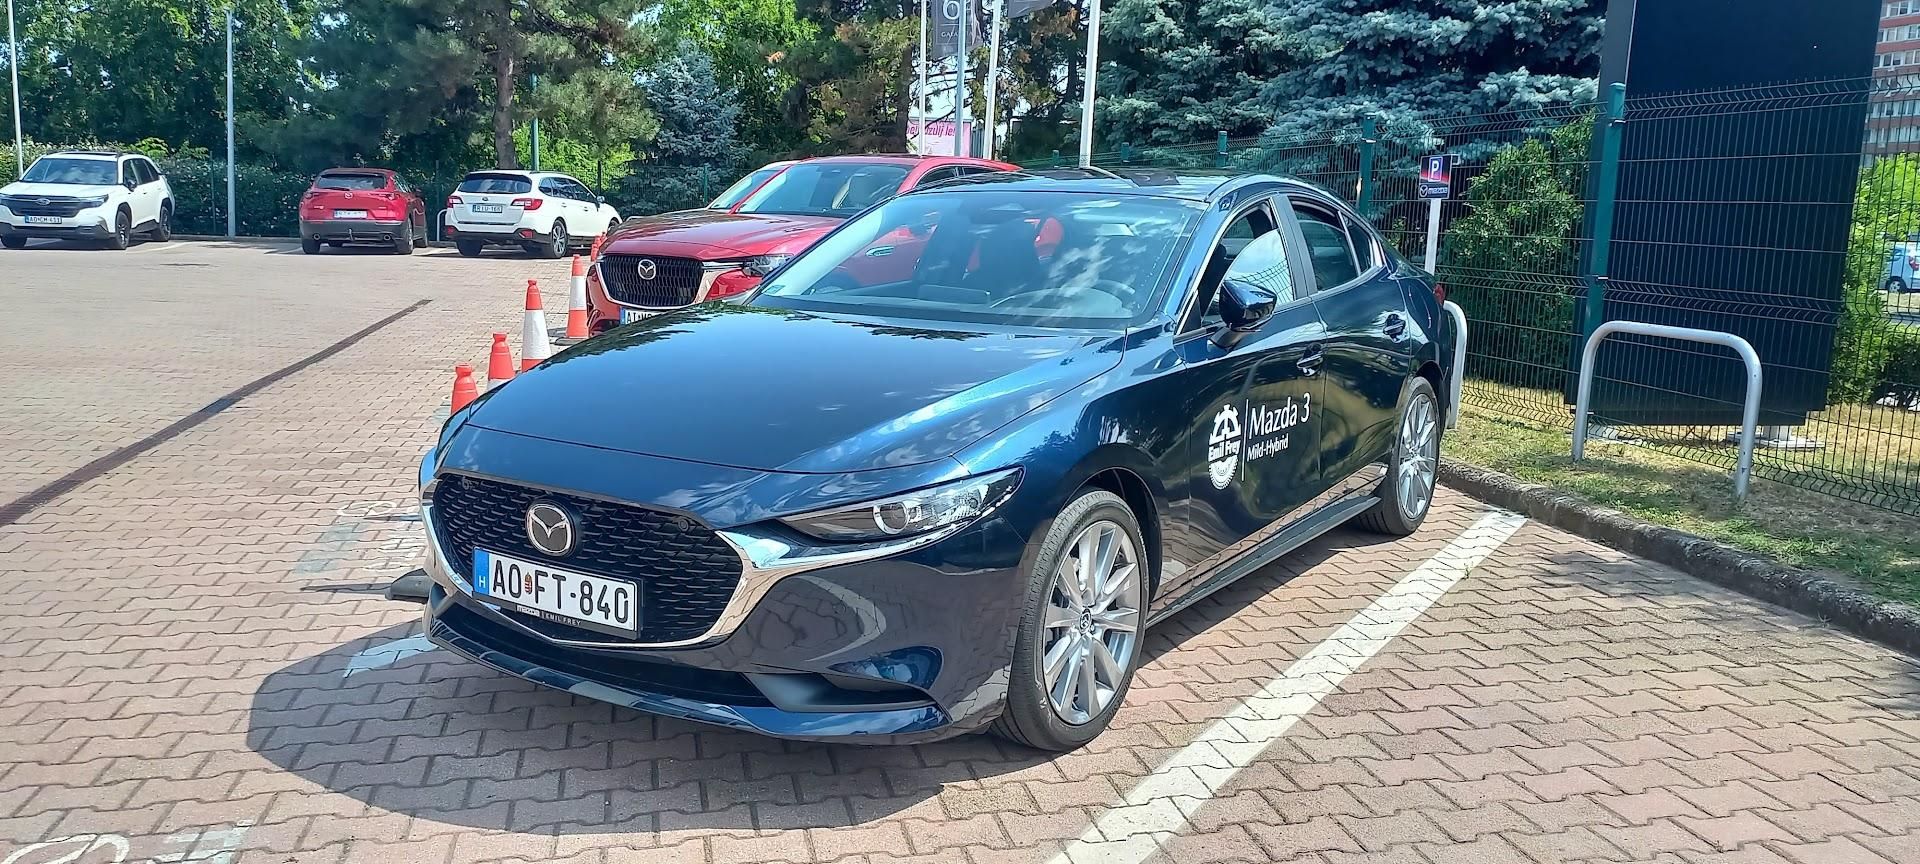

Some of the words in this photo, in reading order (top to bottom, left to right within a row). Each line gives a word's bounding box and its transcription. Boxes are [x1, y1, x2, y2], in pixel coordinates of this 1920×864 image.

[1431, 160, 1440, 179] P
[1249, 397, 1298, 440] Mazda
[1301, 392, 1311, 423] 3
[1208, 441, 1224, 462] Emil
[1225, 440, 1241, 456] Frey
[1247, 433, 1289, 462] Mild-Hybrid
[478, 576, 486, 588] H
[563, 617, 581, 626] FREY
